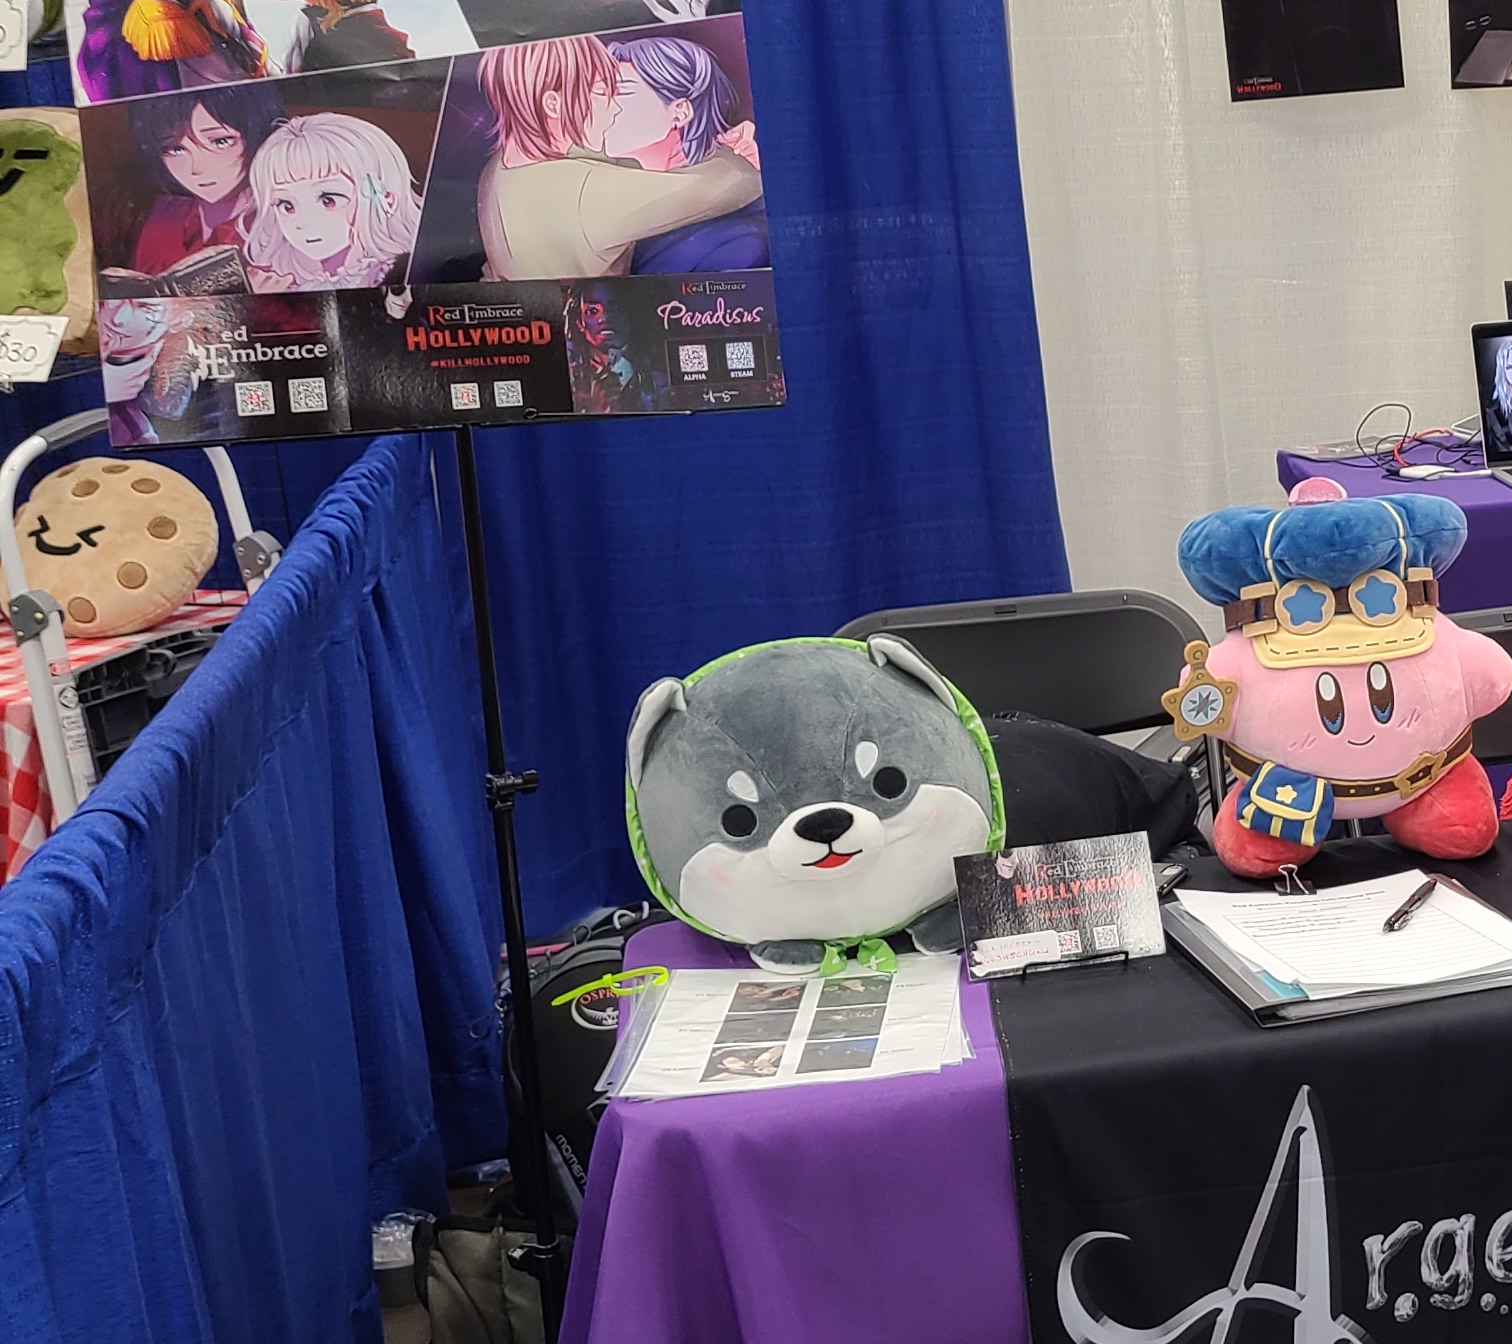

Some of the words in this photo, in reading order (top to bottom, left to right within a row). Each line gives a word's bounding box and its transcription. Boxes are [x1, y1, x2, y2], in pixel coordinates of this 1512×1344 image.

[681, 282, 703, 296] Red
[705, 280, 746, 295] Embrace
[427, 306, 461, 325] Red
[462, 303, 524, 324] Embrace
[656, 297, 764, 329] Paradisus
[405, 320, 552, 351] HOLLYWOOD
[192, 340, 328, 384] Embrace
[730, 370, 754, 378] STEAM
[684, 373, 707, 381] ALPHA
[1014, 869, 1142, 906] HOLLYWOOD
